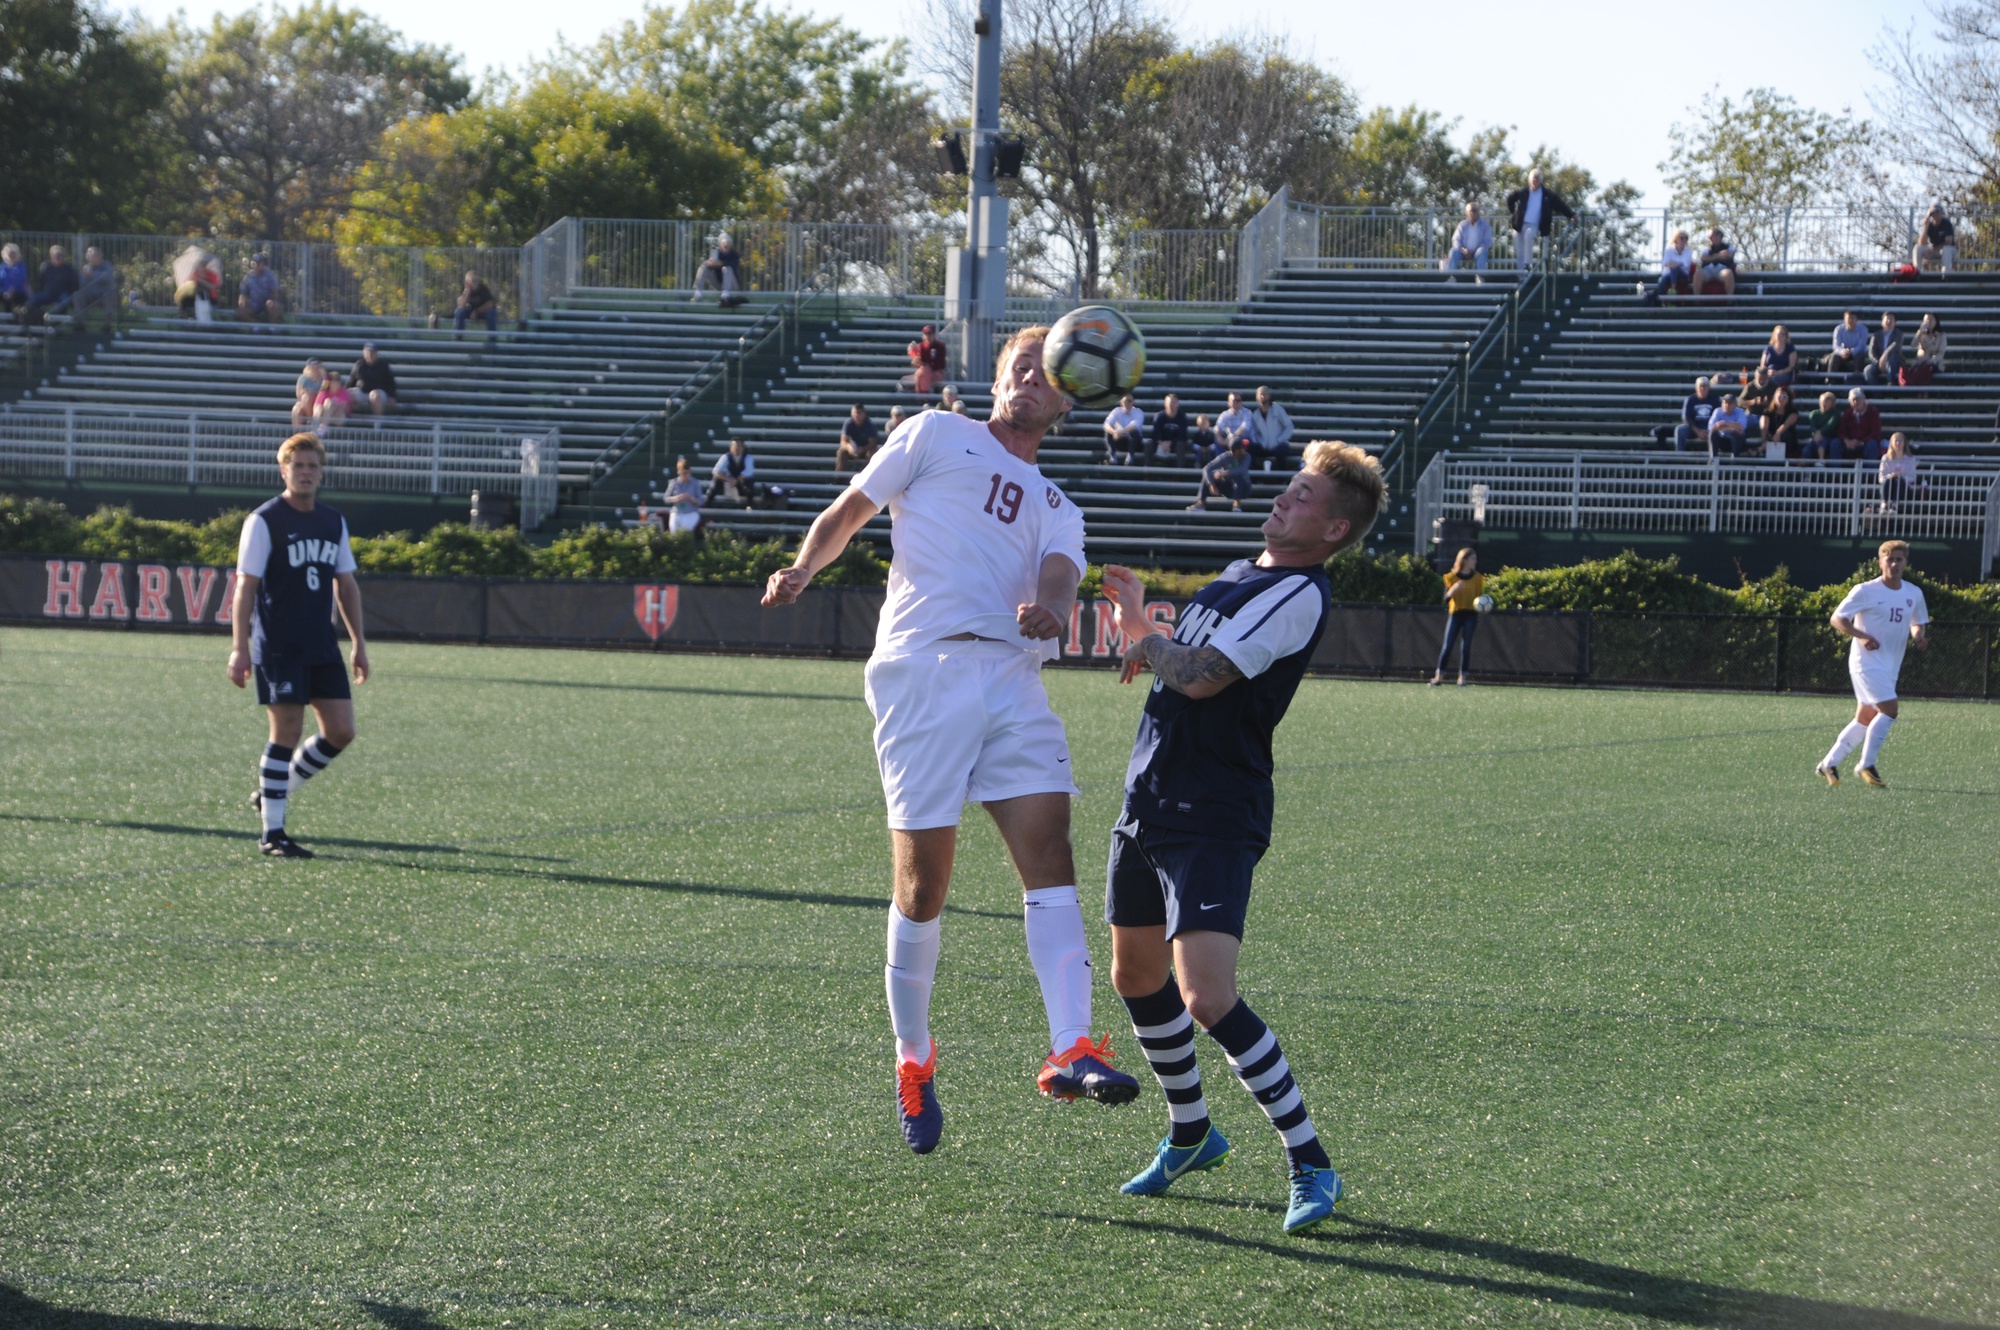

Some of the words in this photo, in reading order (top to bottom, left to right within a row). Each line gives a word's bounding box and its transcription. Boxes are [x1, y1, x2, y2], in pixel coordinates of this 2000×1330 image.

[984, 472, 1025, 525] 19
[287, 538, 339, 568] UNH
[306, 565, 320, 591] 6
[644, 589, 668, 624] H
[1889, 607, 1904, 623] 15
